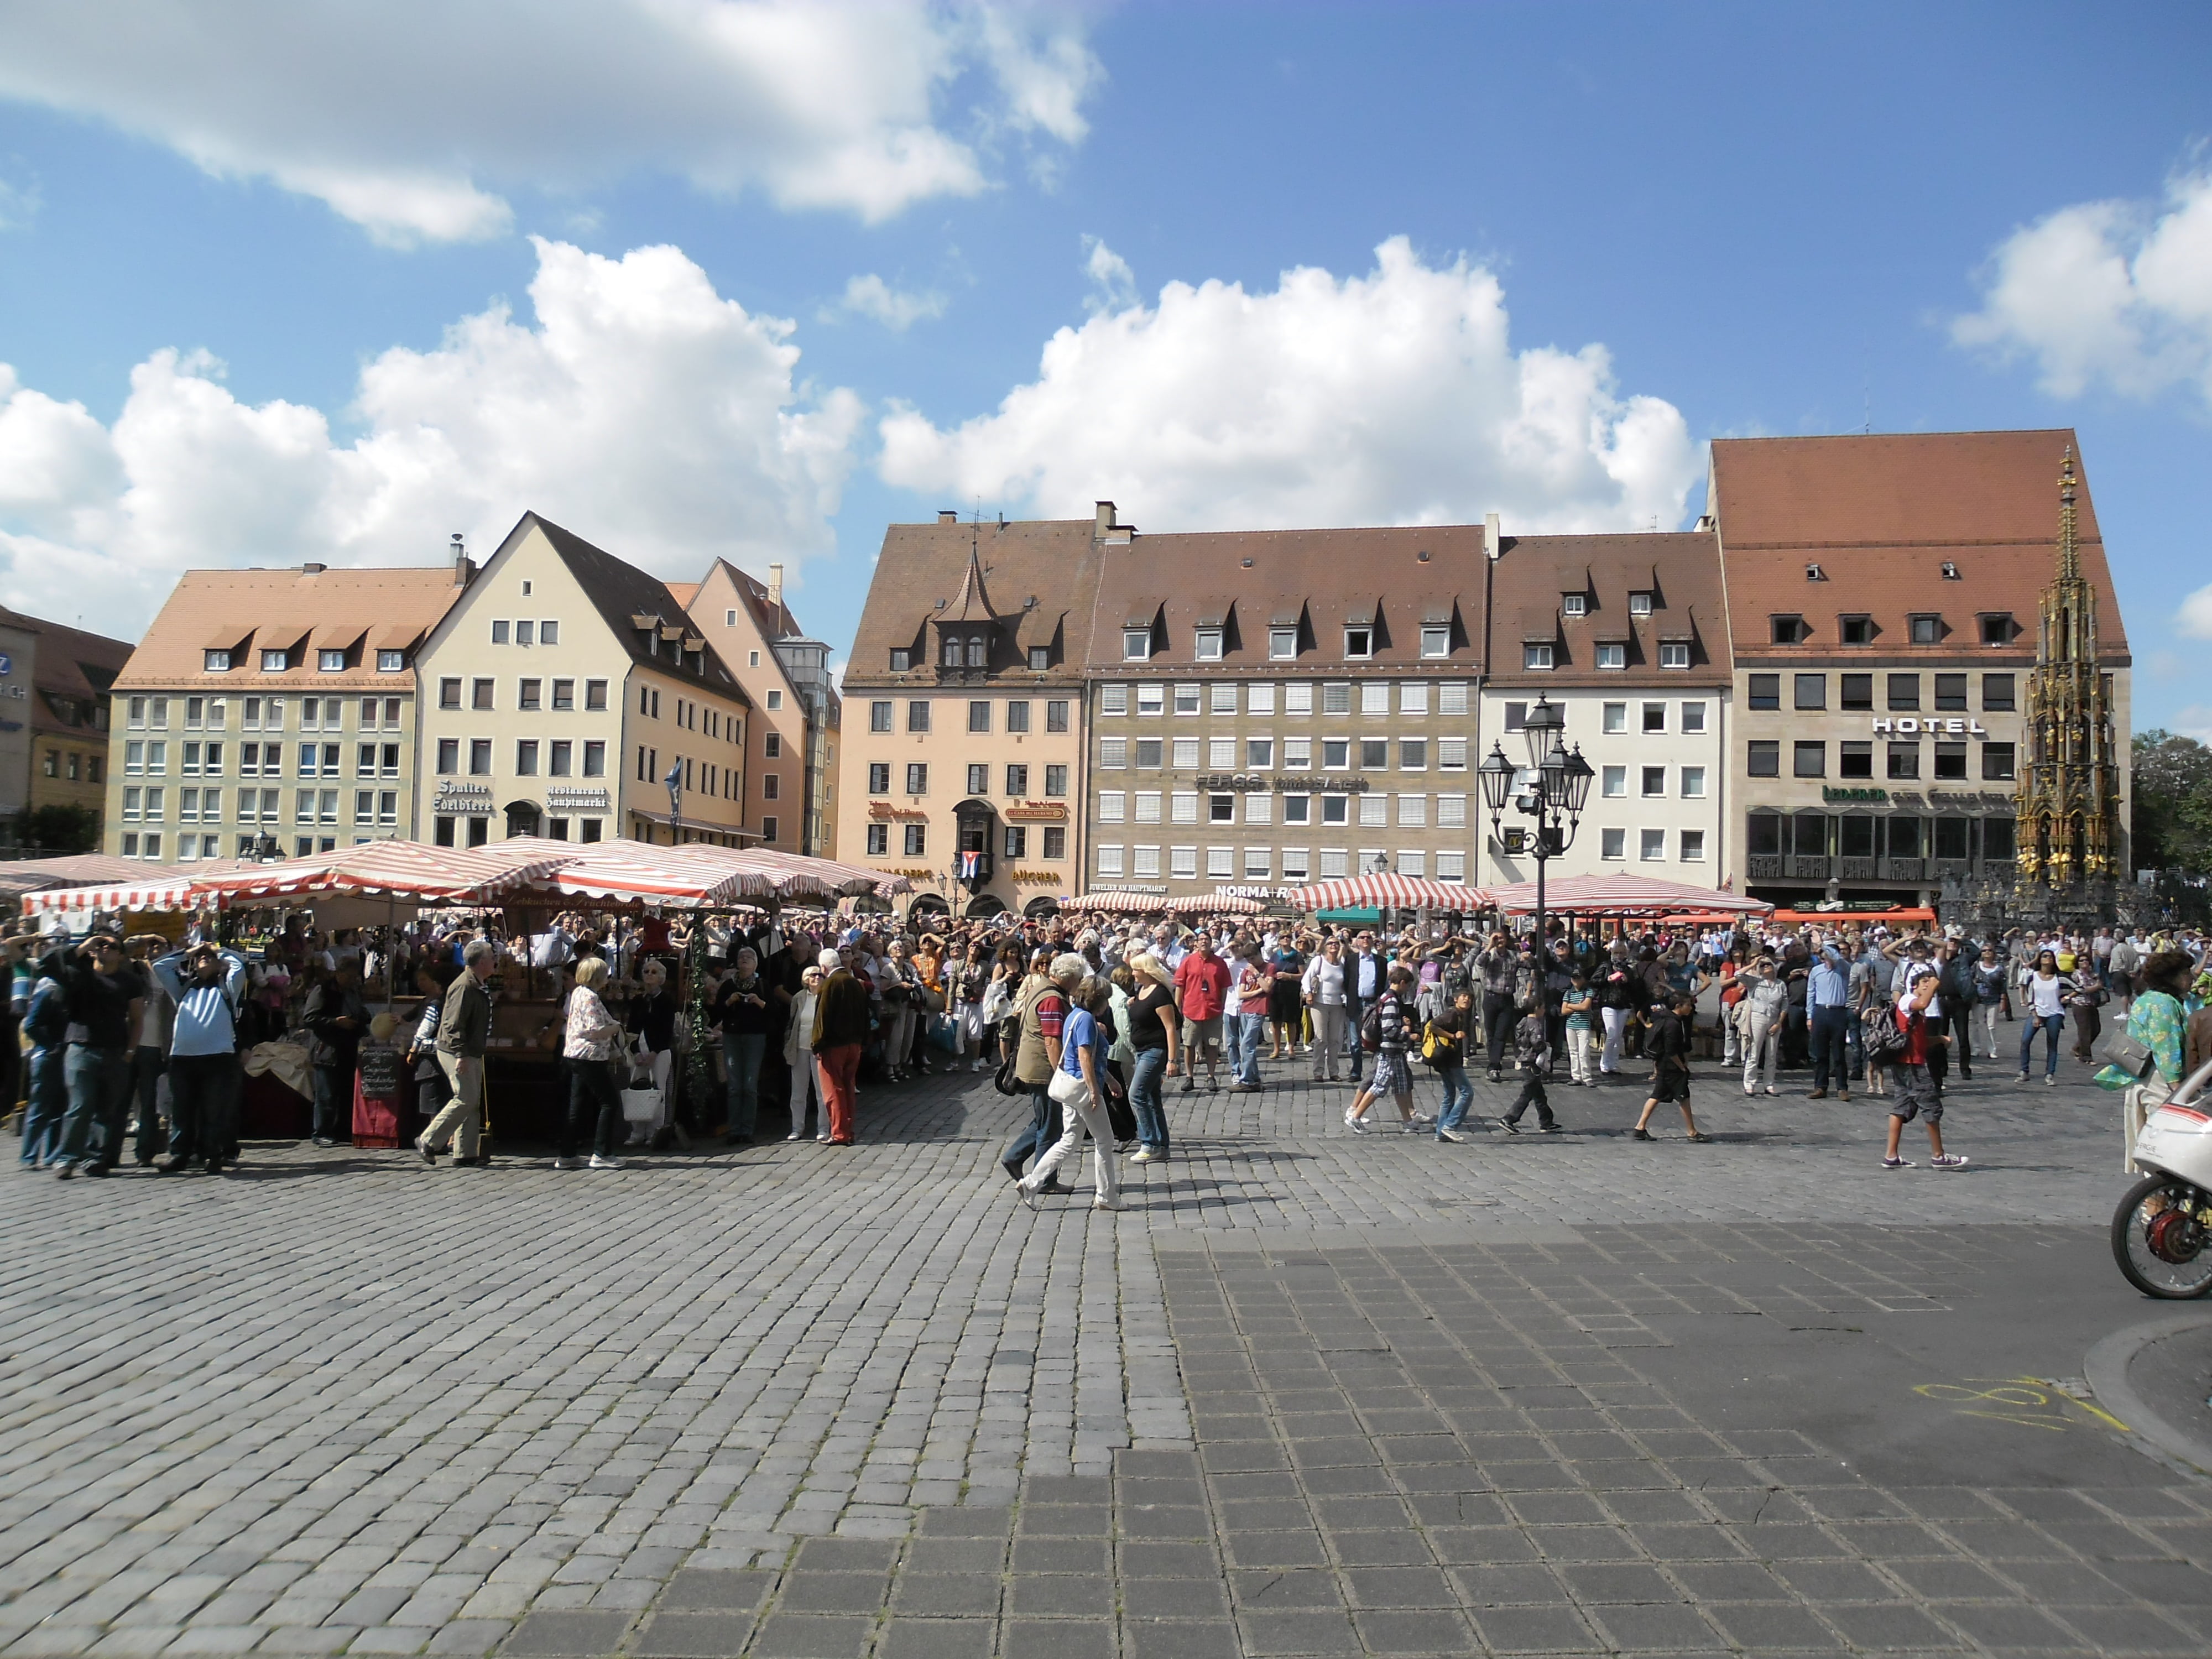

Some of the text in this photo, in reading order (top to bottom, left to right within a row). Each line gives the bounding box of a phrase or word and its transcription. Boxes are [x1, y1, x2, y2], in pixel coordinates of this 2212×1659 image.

[1872, 718, 1985, 733] HOTEL
[438, 780, 488, 795] Spalter
[546, 786, 606, 795] Restaurant
[1822, 785, 1886, 801] LEDERER
[434, 797, 492, 811] Edelbiere
[546, 797, 606, 809] Hauptmarkt
[1215, 885, 1270, 898] NORMA
